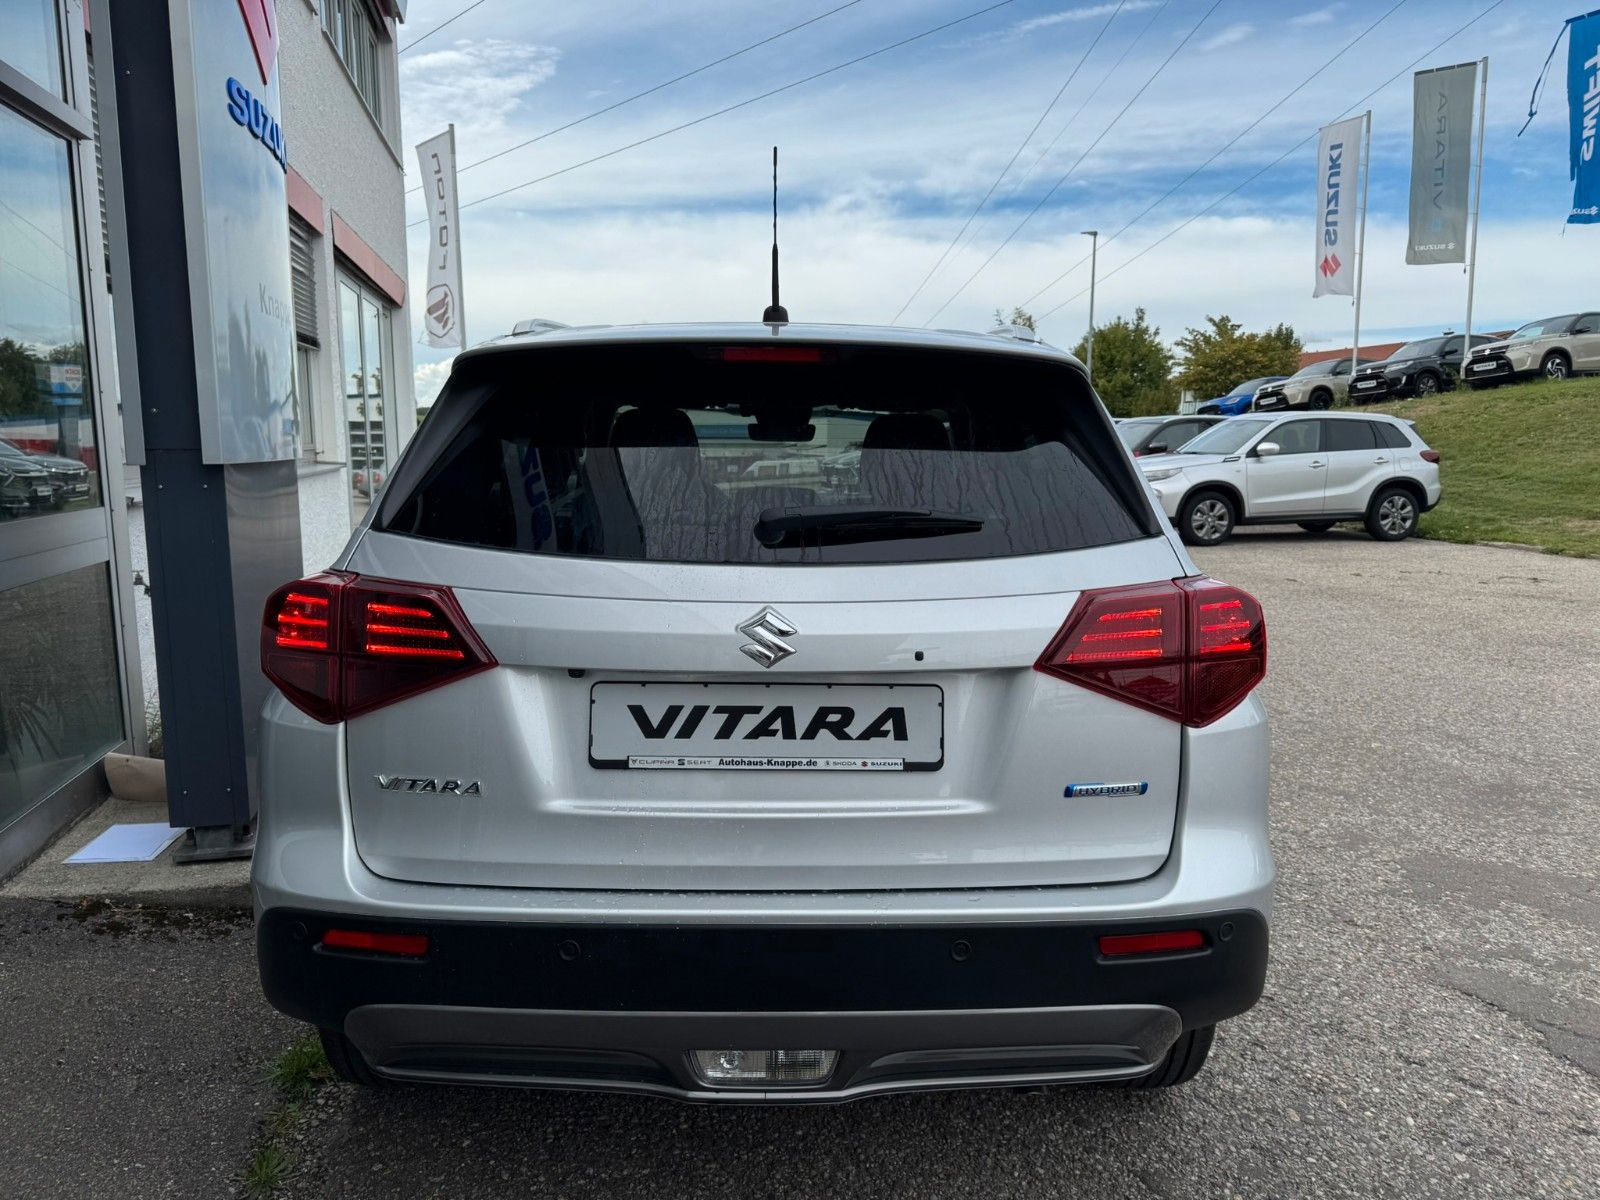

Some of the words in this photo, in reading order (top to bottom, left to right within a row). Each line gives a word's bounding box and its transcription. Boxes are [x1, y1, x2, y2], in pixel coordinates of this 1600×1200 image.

[626, 704, 909, 741] VITARA
[718, 758, 818, 768] Autohaus-Knappe.de
[374, 774, 481, 795] VITARA
[1078, 785, 1138, 796] HYBRID
